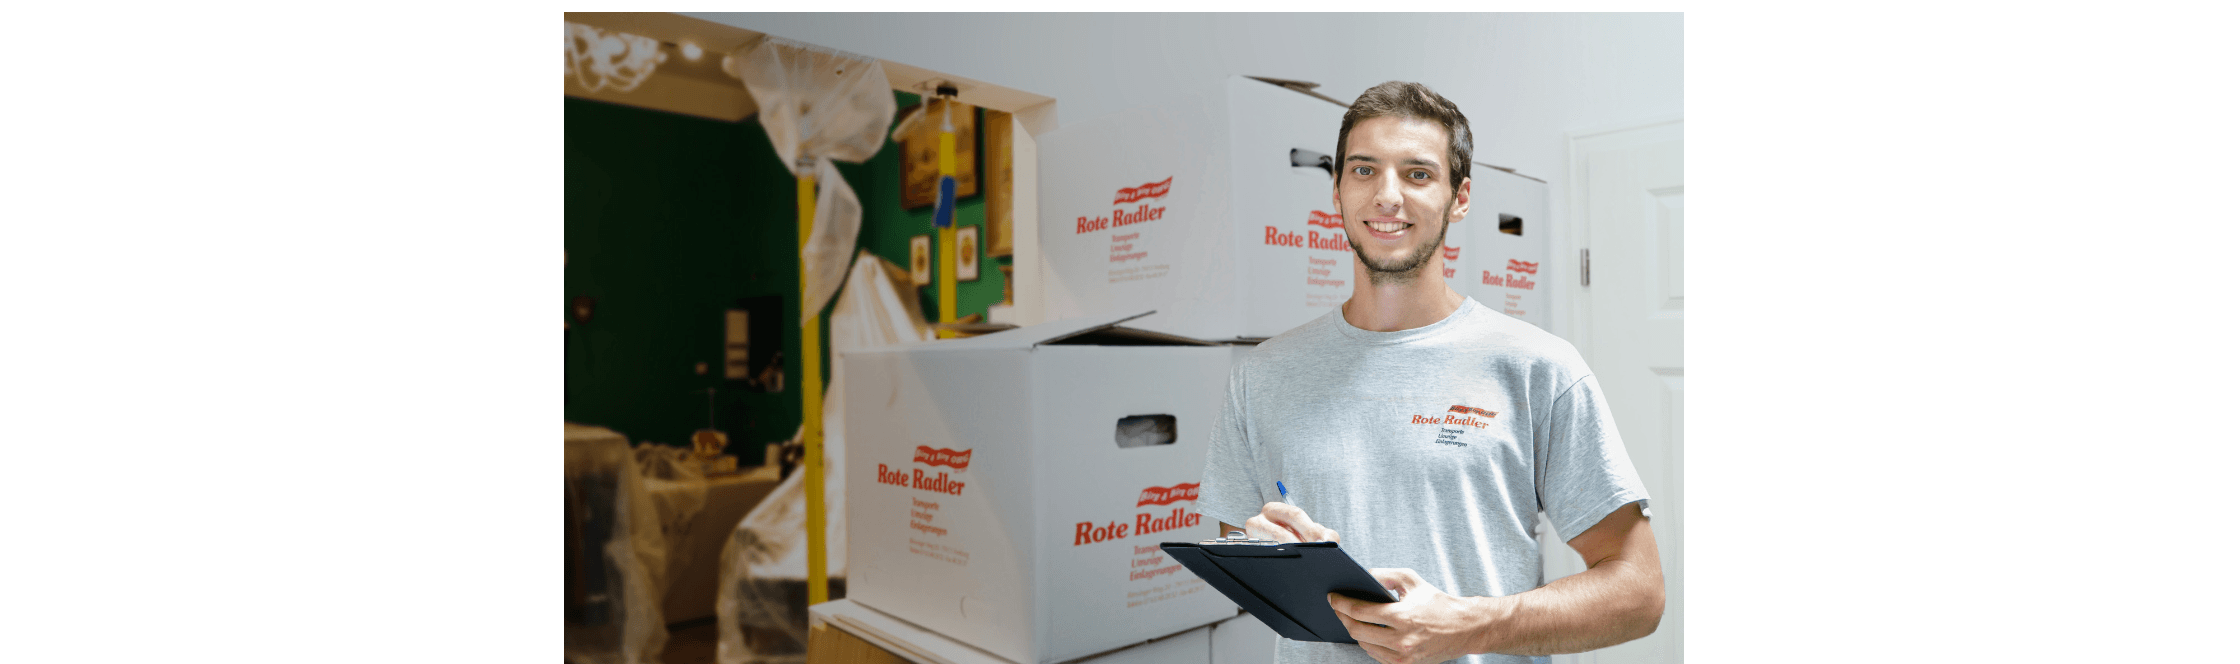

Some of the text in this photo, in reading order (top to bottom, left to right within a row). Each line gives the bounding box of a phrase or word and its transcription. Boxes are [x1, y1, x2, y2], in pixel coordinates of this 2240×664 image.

[1076, 204, 1166, 234] Rote Radler
[1264, 225, 1354, 252] Rote Radle
[1482, 270, 1535, 290] Rote Radler
[1411, 414, 1489, 430] Rote Radler
[877, 463, 965, 496] Rote Radler
[1074, 507, 1202, 546] Rote Radler
